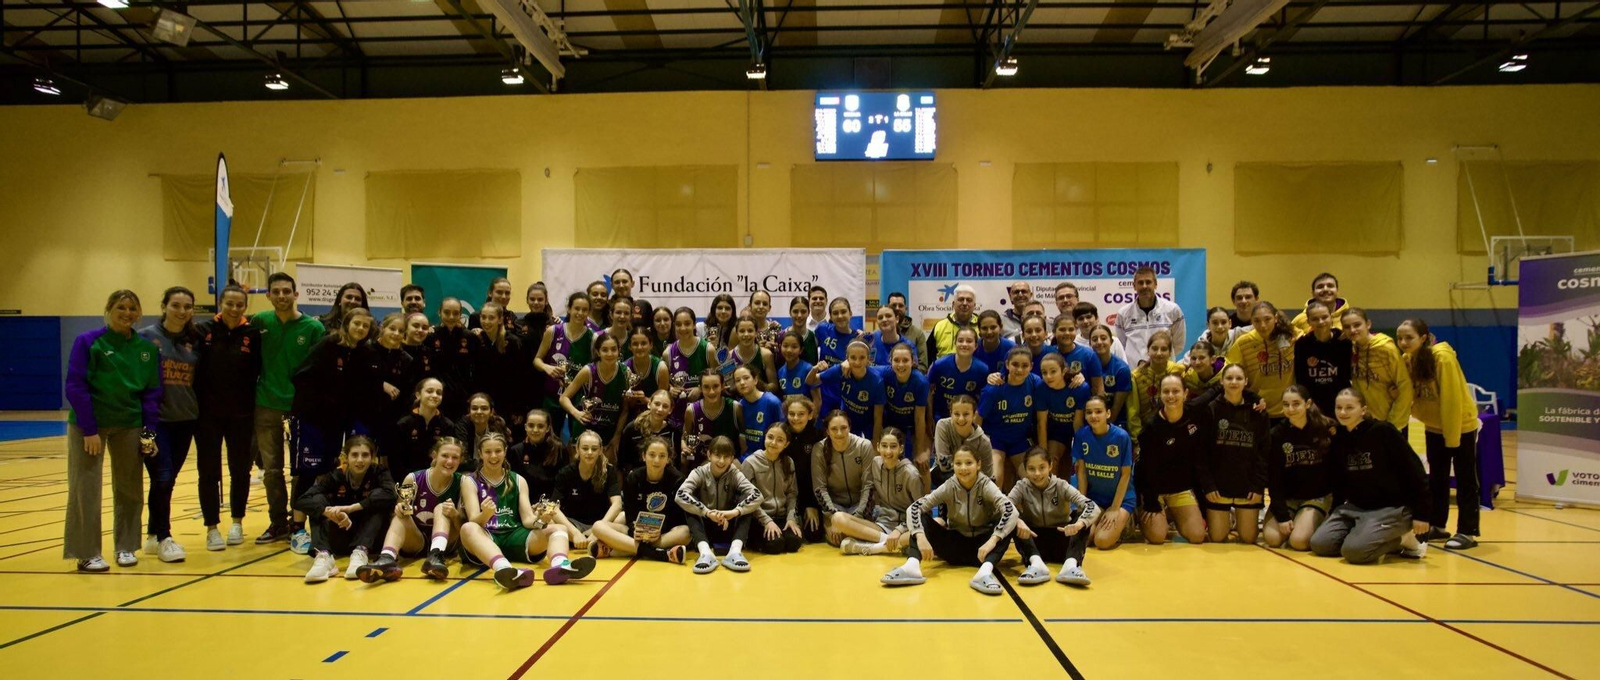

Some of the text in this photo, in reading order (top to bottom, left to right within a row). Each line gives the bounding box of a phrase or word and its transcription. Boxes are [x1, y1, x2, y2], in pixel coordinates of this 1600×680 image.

[911, 263, 947, 277] XVIII
[951, 262, 1015, 276] TORNEO
[1018, 261, 1103, 276] CEMENTOS
[639, 276, 732, 293] Fundación
[306, 288, 320, 296] 952
[824, 337, 838, 350] 45
[940, 376, 955, 390] 22
[997, 400, 1007, 411] 10
[1558, 407, 1591, 416] fábrica
[1539, 416, 1591, 424] SOSTENIBLE
[1081, 442, 1089, 455] 9
